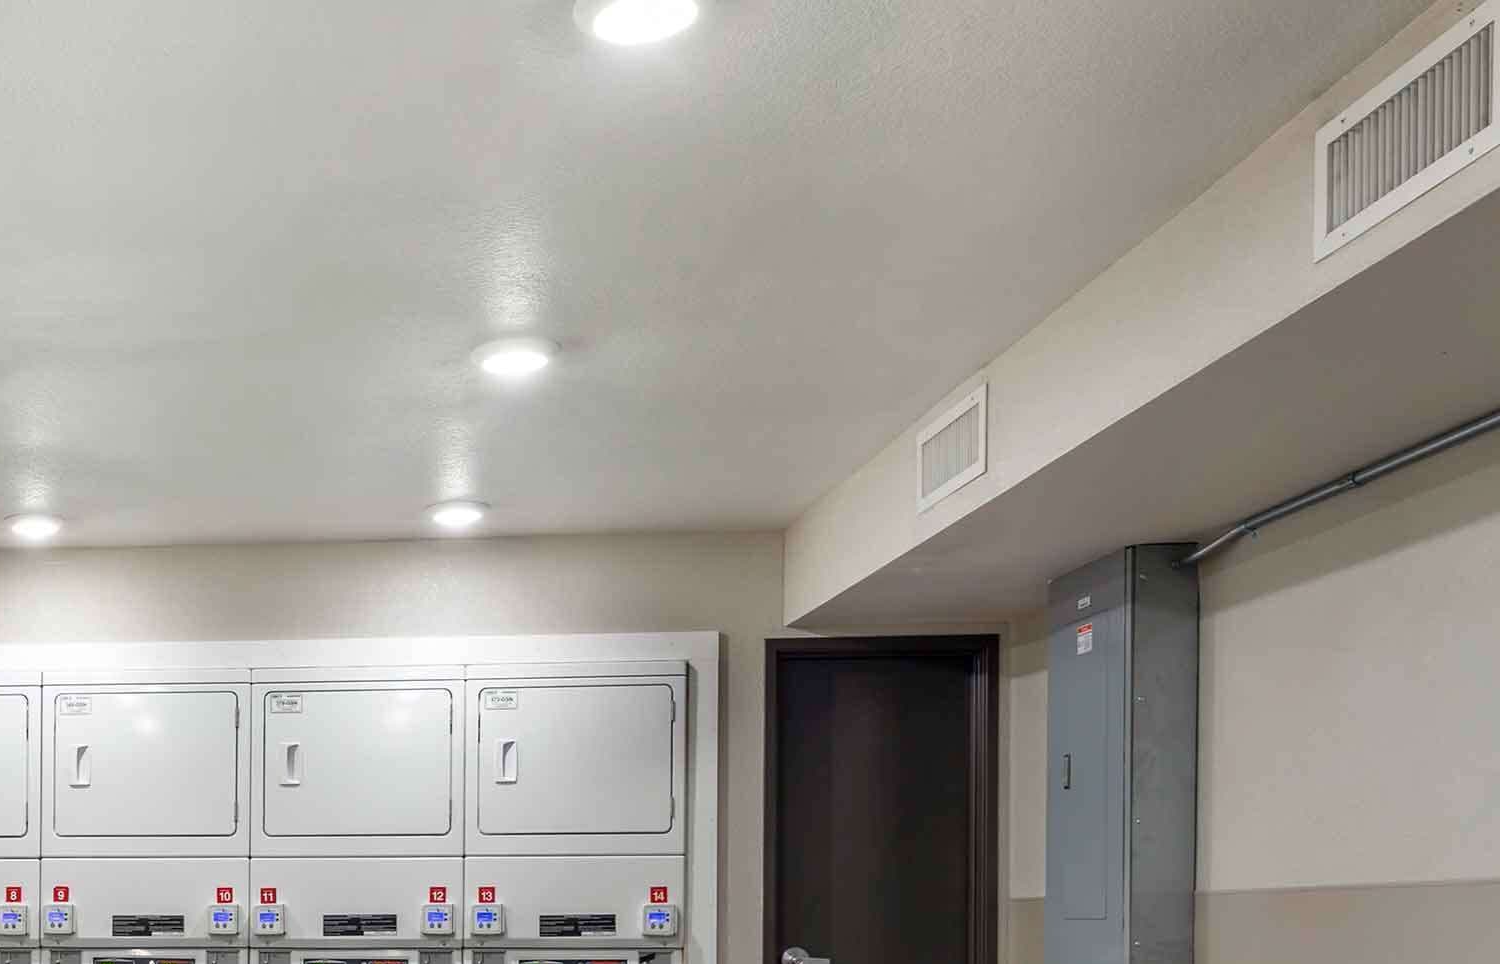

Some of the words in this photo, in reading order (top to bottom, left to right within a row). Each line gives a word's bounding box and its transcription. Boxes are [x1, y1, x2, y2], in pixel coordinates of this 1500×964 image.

[10, 891, 17, 900] 8
[57, 891, 64, 900] 9
[220, 892, 231, 901] 10
[262, 892, 274, 902] 11
[432, 891, 444, 901] 12
[481, 891, 492, 901] 13
[652, 891, 665, 901] 14
